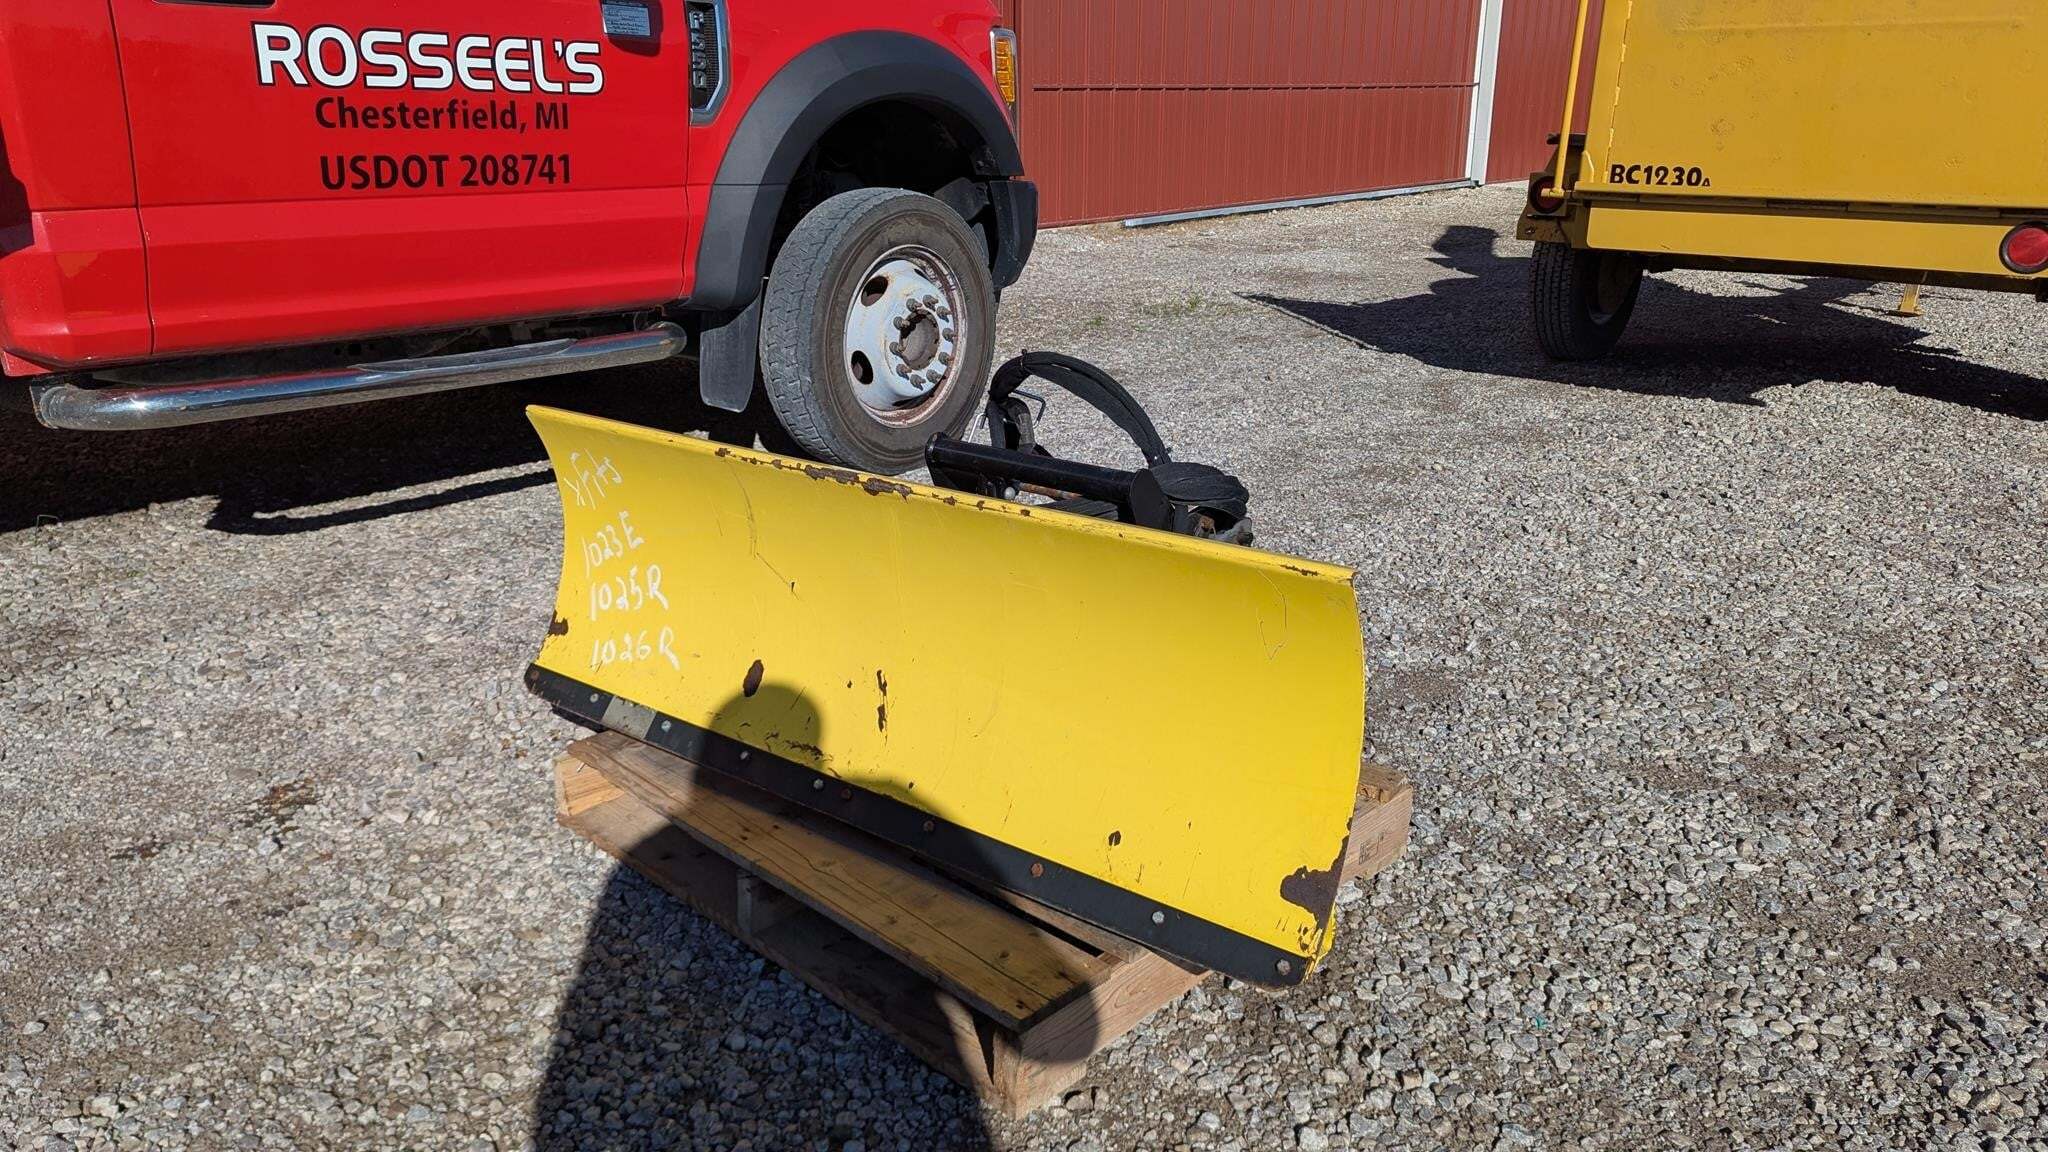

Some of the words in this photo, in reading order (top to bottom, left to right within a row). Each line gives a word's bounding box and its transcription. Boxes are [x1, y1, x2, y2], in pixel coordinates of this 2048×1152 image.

[253, 22, 604, 95] ROSSEEL'S
[315, 97, 526, 132] Chesterfield,
[535, 102, 569, 130] MI
[320, 154, 449, 190] USDOT
[460, 154, 571, 187] 208741
